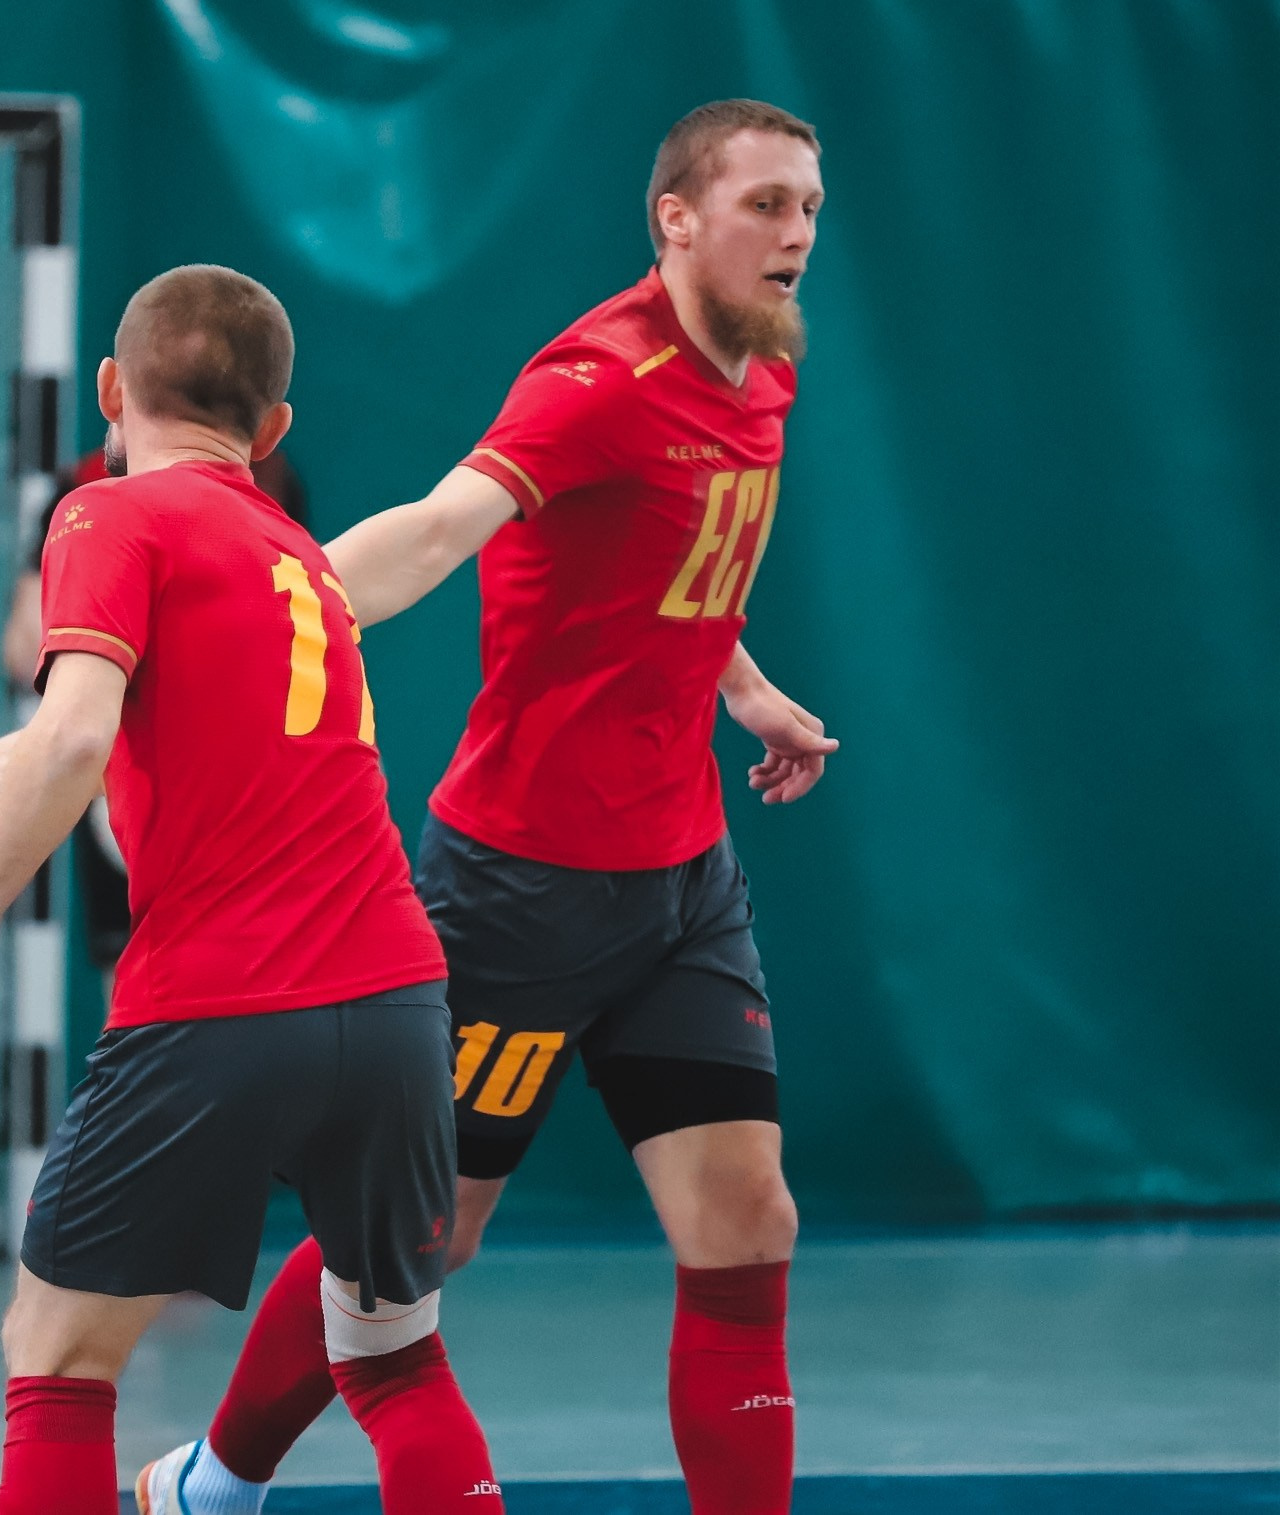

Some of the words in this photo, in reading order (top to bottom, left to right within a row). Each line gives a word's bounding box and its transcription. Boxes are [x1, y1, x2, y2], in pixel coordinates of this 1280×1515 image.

[665, 445, 724, 460] KELME
[50, 520, 94, 544] KELME
[453, 1021, 566, 1117] 10
